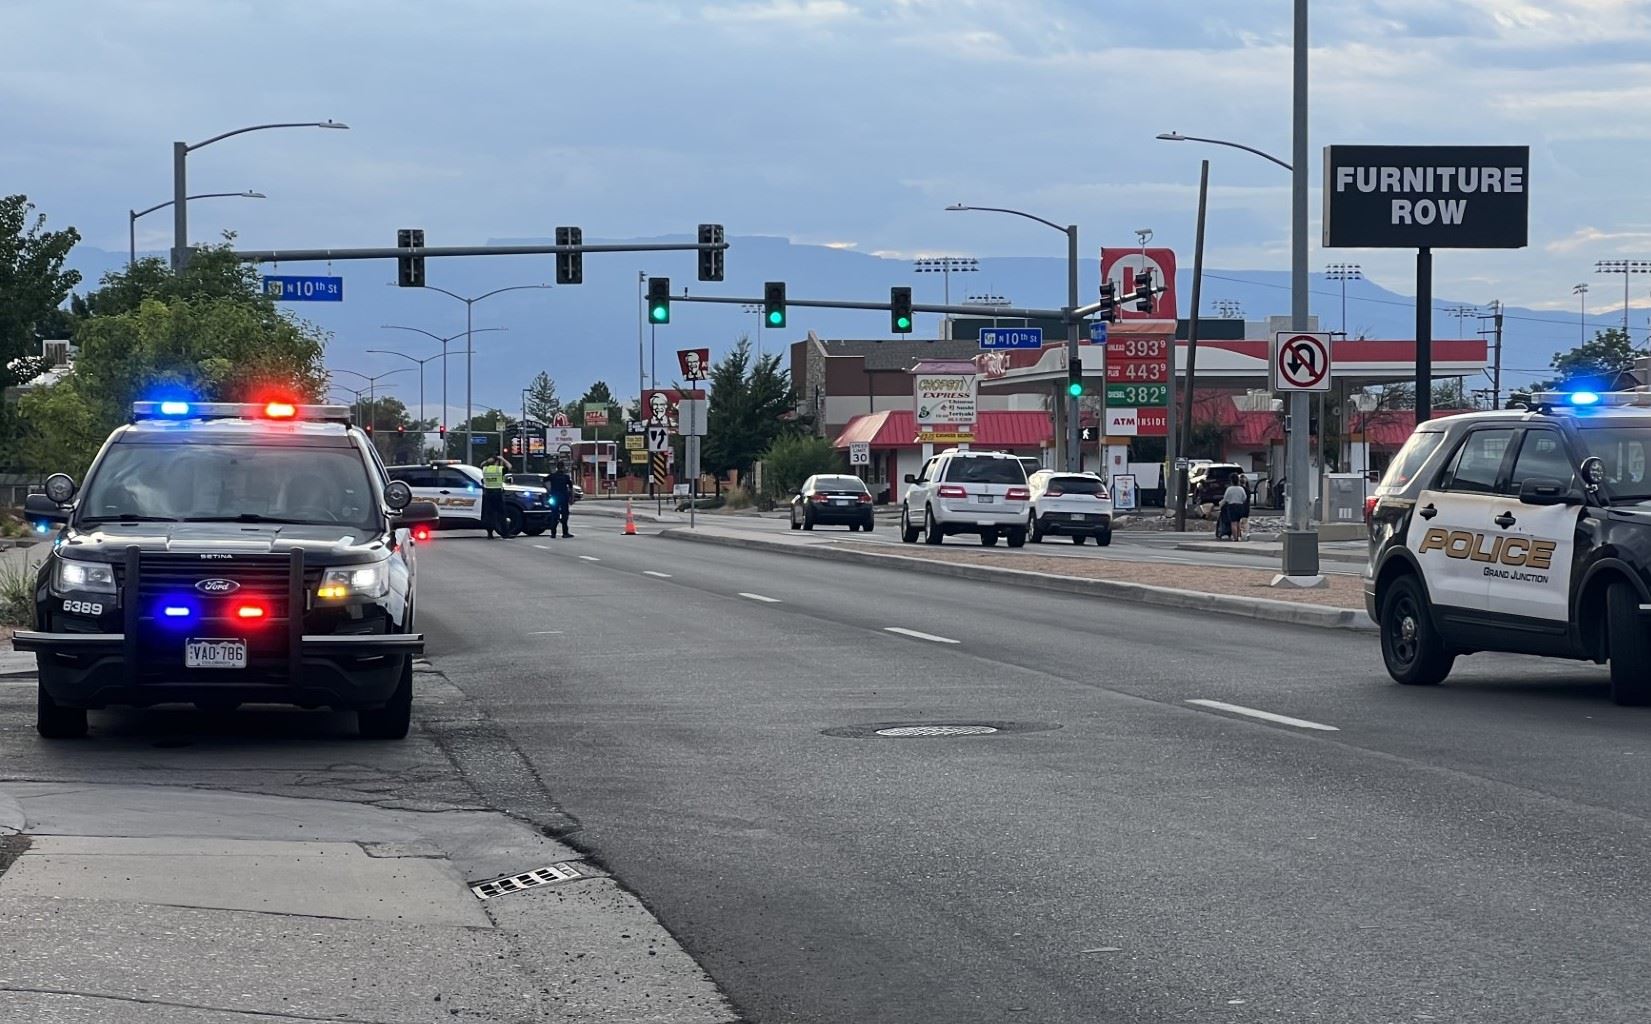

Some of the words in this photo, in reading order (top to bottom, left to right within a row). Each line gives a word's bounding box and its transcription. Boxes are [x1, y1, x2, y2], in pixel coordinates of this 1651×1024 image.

[1336, 167, 1523, 193] FURNITURE
[1391, 199, 1467, 225] ROW
[287, 284, 294, 292] N
[297, 281, 325, 296] 10th
[328, 284, 337, 293] St
[1006, 333, 1028, 344] 10th
[1030, 334, 1037, 342] St
[1113, 418, 1135, 426] ATM
[1137, 417, 1166, 426] INSIDE
[853, 454, 867, 462] 30
[1419, 527, 1557, 569] POLICE
[63, 600, 103, 615] 6389
